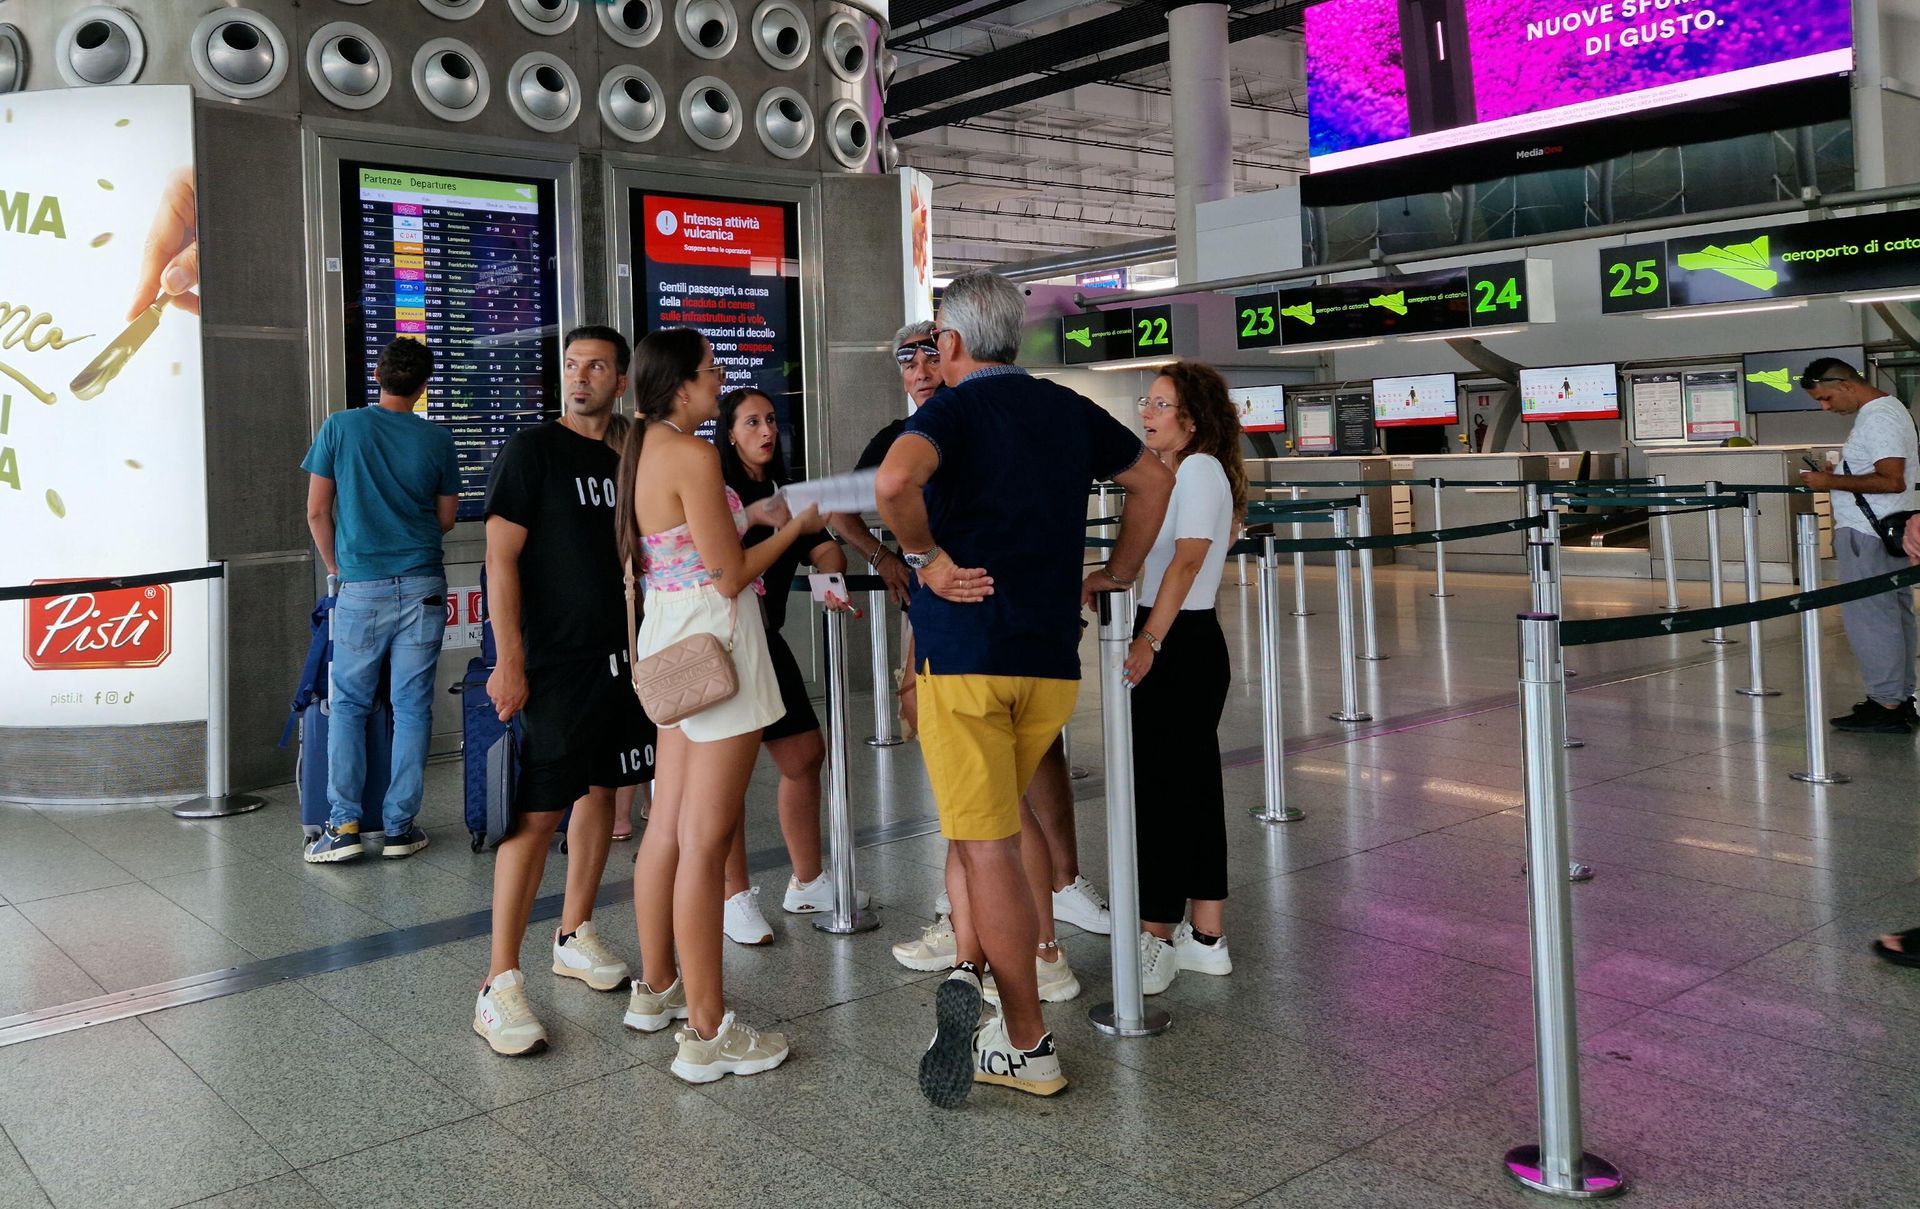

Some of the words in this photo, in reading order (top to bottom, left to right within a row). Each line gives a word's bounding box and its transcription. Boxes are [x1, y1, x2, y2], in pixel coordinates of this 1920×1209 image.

[1527, 4, 1614, 41] NUOVE
[1621, 0, 1696, 18] SFU
[1586, 33, 1611, 56] DI
[1619, 10, 1725, 47] GUSTO.
[364, 173, 402, 186] Partenze
[410, 178, 457, 191] Departures
[683, 211, 723, 227] Intensa
[724, 216, 760, 230] attività
[683, 225, 734, 241] vulcanica
[1609, 259, 1659, 298] 25
[1781, 244, 1859, 262] aeroporto
[1864, 239, 1879, 254] di
[1884, 237, 1920, 251] cata
[659, 281, 687, 293] Gentili
[688, 284, 737, 297] passeggeri,
[737, 287, 743, 295] a
[744, 287, 769, 297] causa
[1407, 295, 1437, 304] aeroporto
[1444, 291, 1468, 299] catania
[1474, 277, 1522, 313] 24
[659, 296, 681, 307] della
[682, 297, 717, 309] ricaduta
[718, 298, 726, 309] di
[727, 300, 756, 310] cenere
[660, 310, 681, 321] sulle
[682, 311, 737, 323] infrastrutture
[738, 313, 746, 323] di
[1241, 306, 1275, 337] 23
[1315, 306, 1342, 315] aeroporto
[1348, 302, 1369, 310] catania
[736, 327, 745, 337] di
[746, 328, 776, 338] decollo
[1138, 317, 1169, 346] 22
[716, 342, 737, 351] sono
[738, 344, 775, 353] sospese.
[750, 357, 764, 367] per
[725, 369, 752, 381] rapida
[575, 476, 616, 508] ICO
[36, 592, 159, 657] Pistì
[50, 692, 83, 706] pisti.it
[620, 744, 654, 774] ICO
